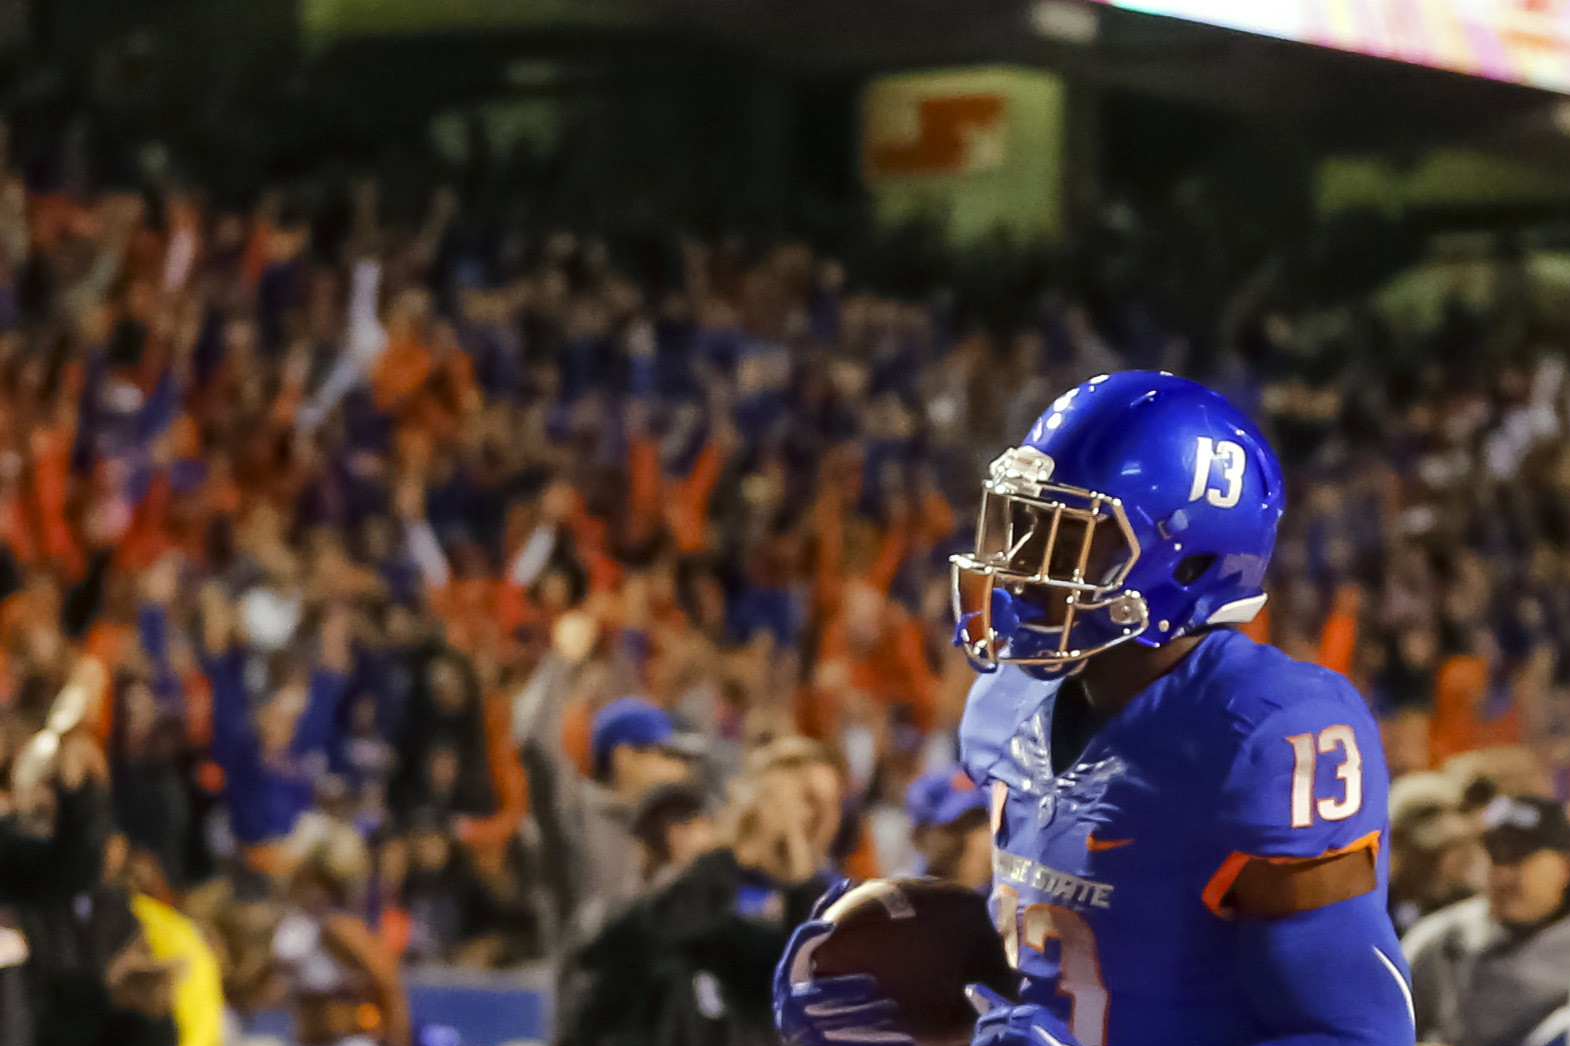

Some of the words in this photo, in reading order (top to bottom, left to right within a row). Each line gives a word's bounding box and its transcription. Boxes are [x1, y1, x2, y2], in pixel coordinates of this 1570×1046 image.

[1188, 436, 1246, 508] 13
[1285, 724, 1363, 828] 13
[1031, 863, 1114, 909] STATE
